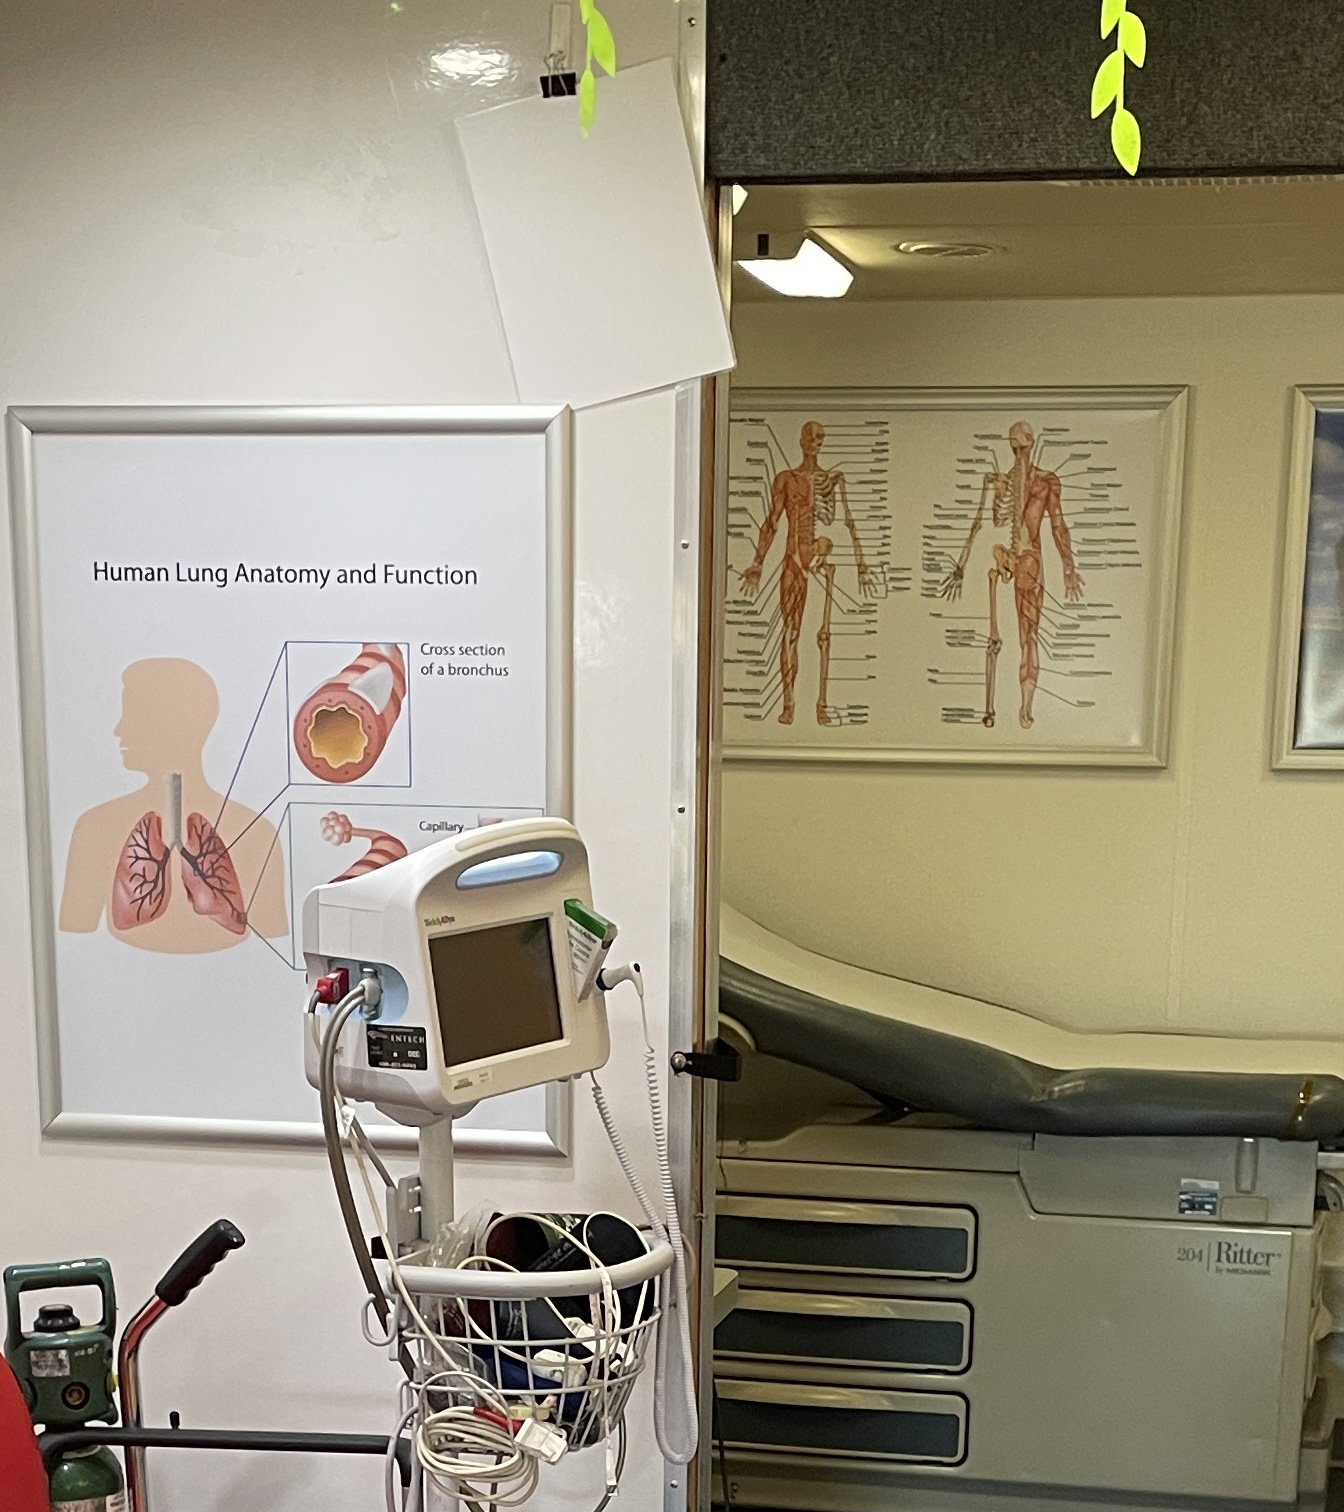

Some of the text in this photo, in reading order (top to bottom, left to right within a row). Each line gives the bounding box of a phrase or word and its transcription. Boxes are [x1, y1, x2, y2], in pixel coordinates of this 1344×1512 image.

[93, 561, 478, 590] Human Lung Anatomy and Function
[419, 643, 506, 658] Cross section
[420, 663, 509, 679] of a bronchus
[419, 820, 464, 833] Capillary
[1176, 1241, 1276, 1268] 204 Ritter
